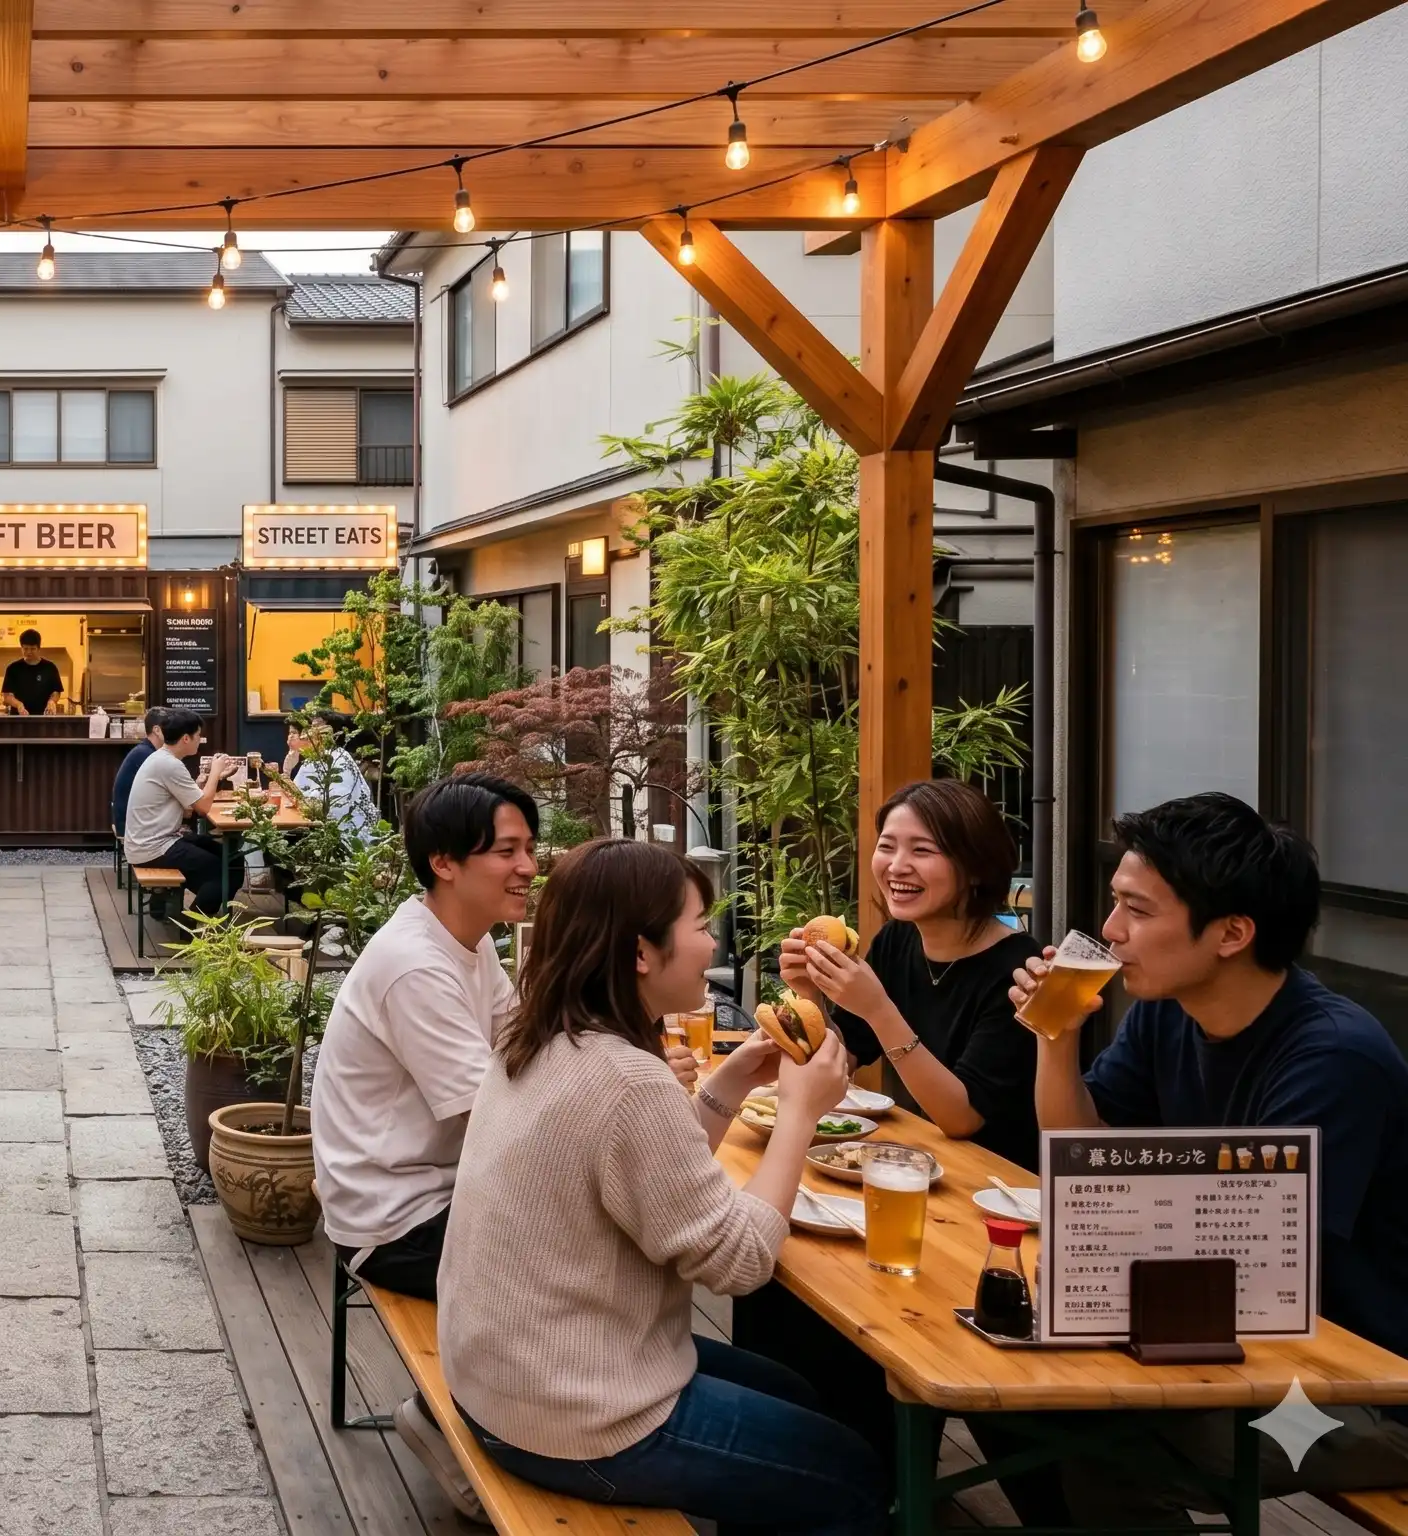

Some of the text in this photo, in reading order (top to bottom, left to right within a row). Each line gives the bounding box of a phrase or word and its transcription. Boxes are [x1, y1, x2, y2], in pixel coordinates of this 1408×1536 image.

[36, 522, 117, 549] BEER
[258, 526, 382, 545] STREET EATS
